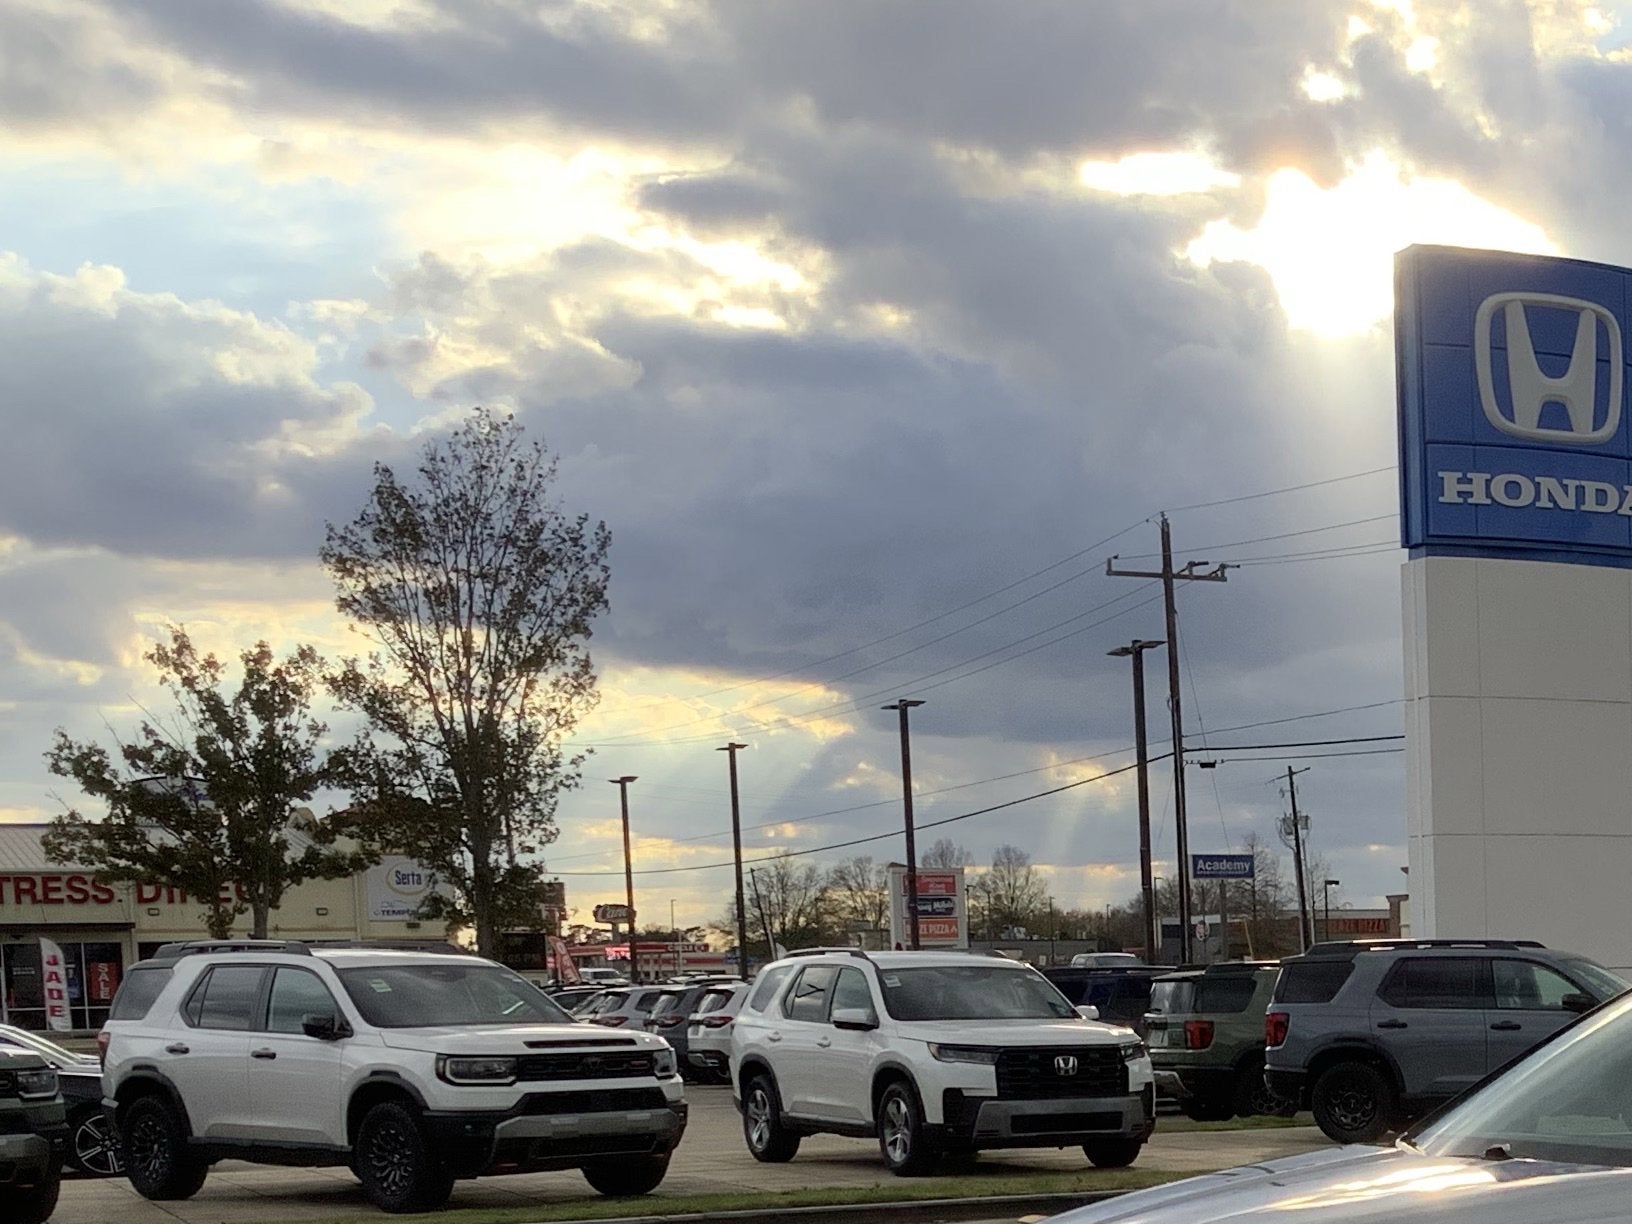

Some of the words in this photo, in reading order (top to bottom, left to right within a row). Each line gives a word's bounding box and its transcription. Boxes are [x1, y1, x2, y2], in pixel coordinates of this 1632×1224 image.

[1197, 859, 1251, 873] Academy
[395, 869, 422, 886] Serta
[929, 924, 950, 934] PIZZA
[98, 962, 111, 1000] SALE
